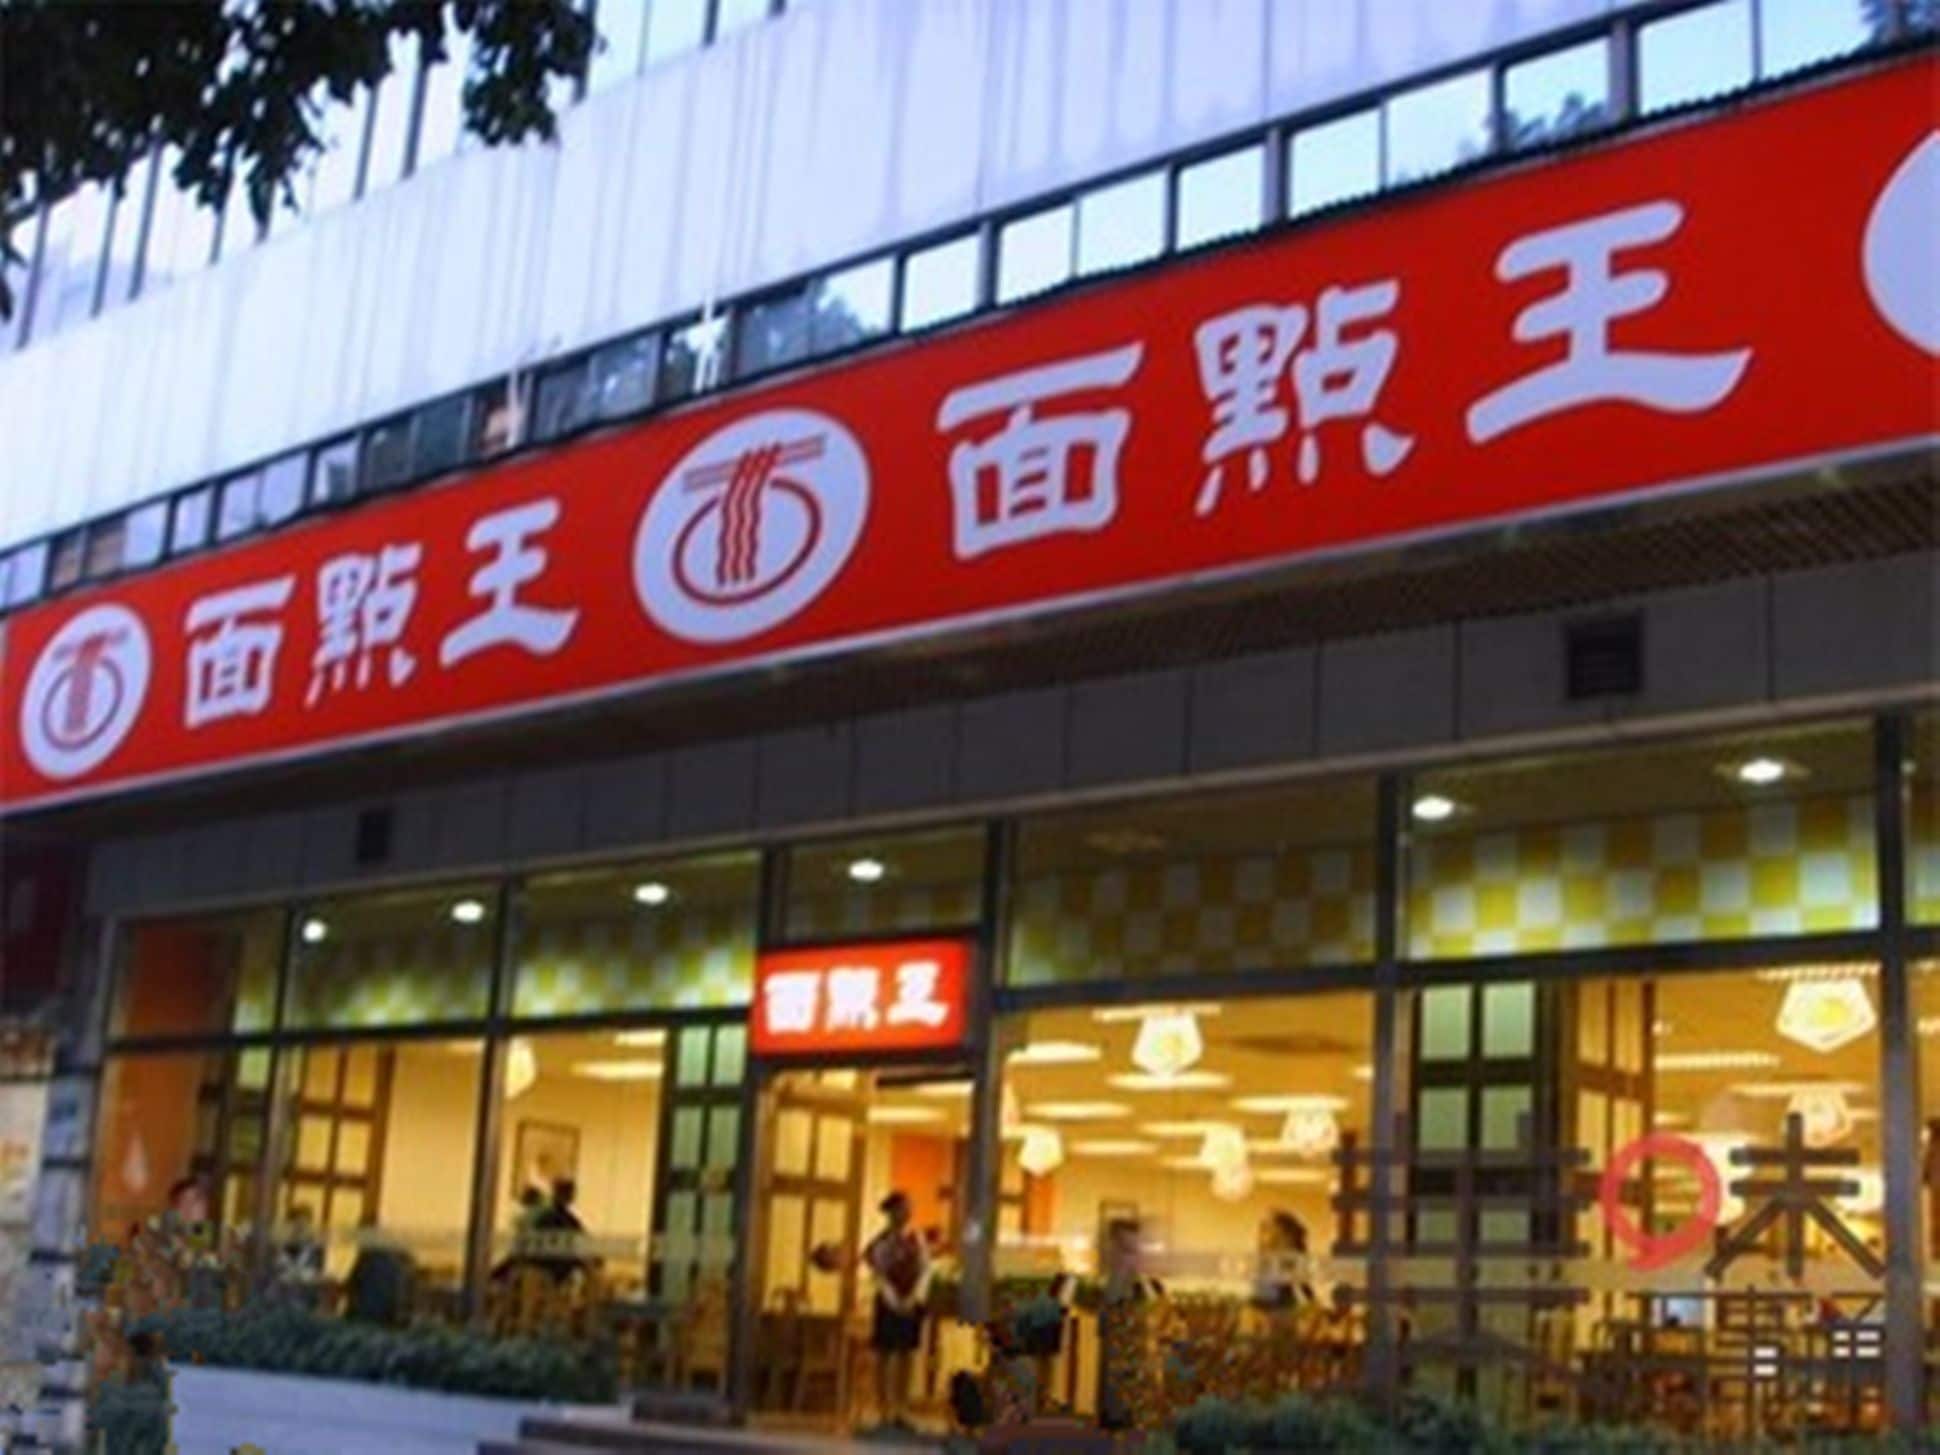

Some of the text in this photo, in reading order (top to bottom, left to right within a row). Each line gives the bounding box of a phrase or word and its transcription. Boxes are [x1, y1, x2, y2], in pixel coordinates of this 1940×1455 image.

[937, 200, 1752, 560] 面點王
[184, 498, 580, 729] 面點王
